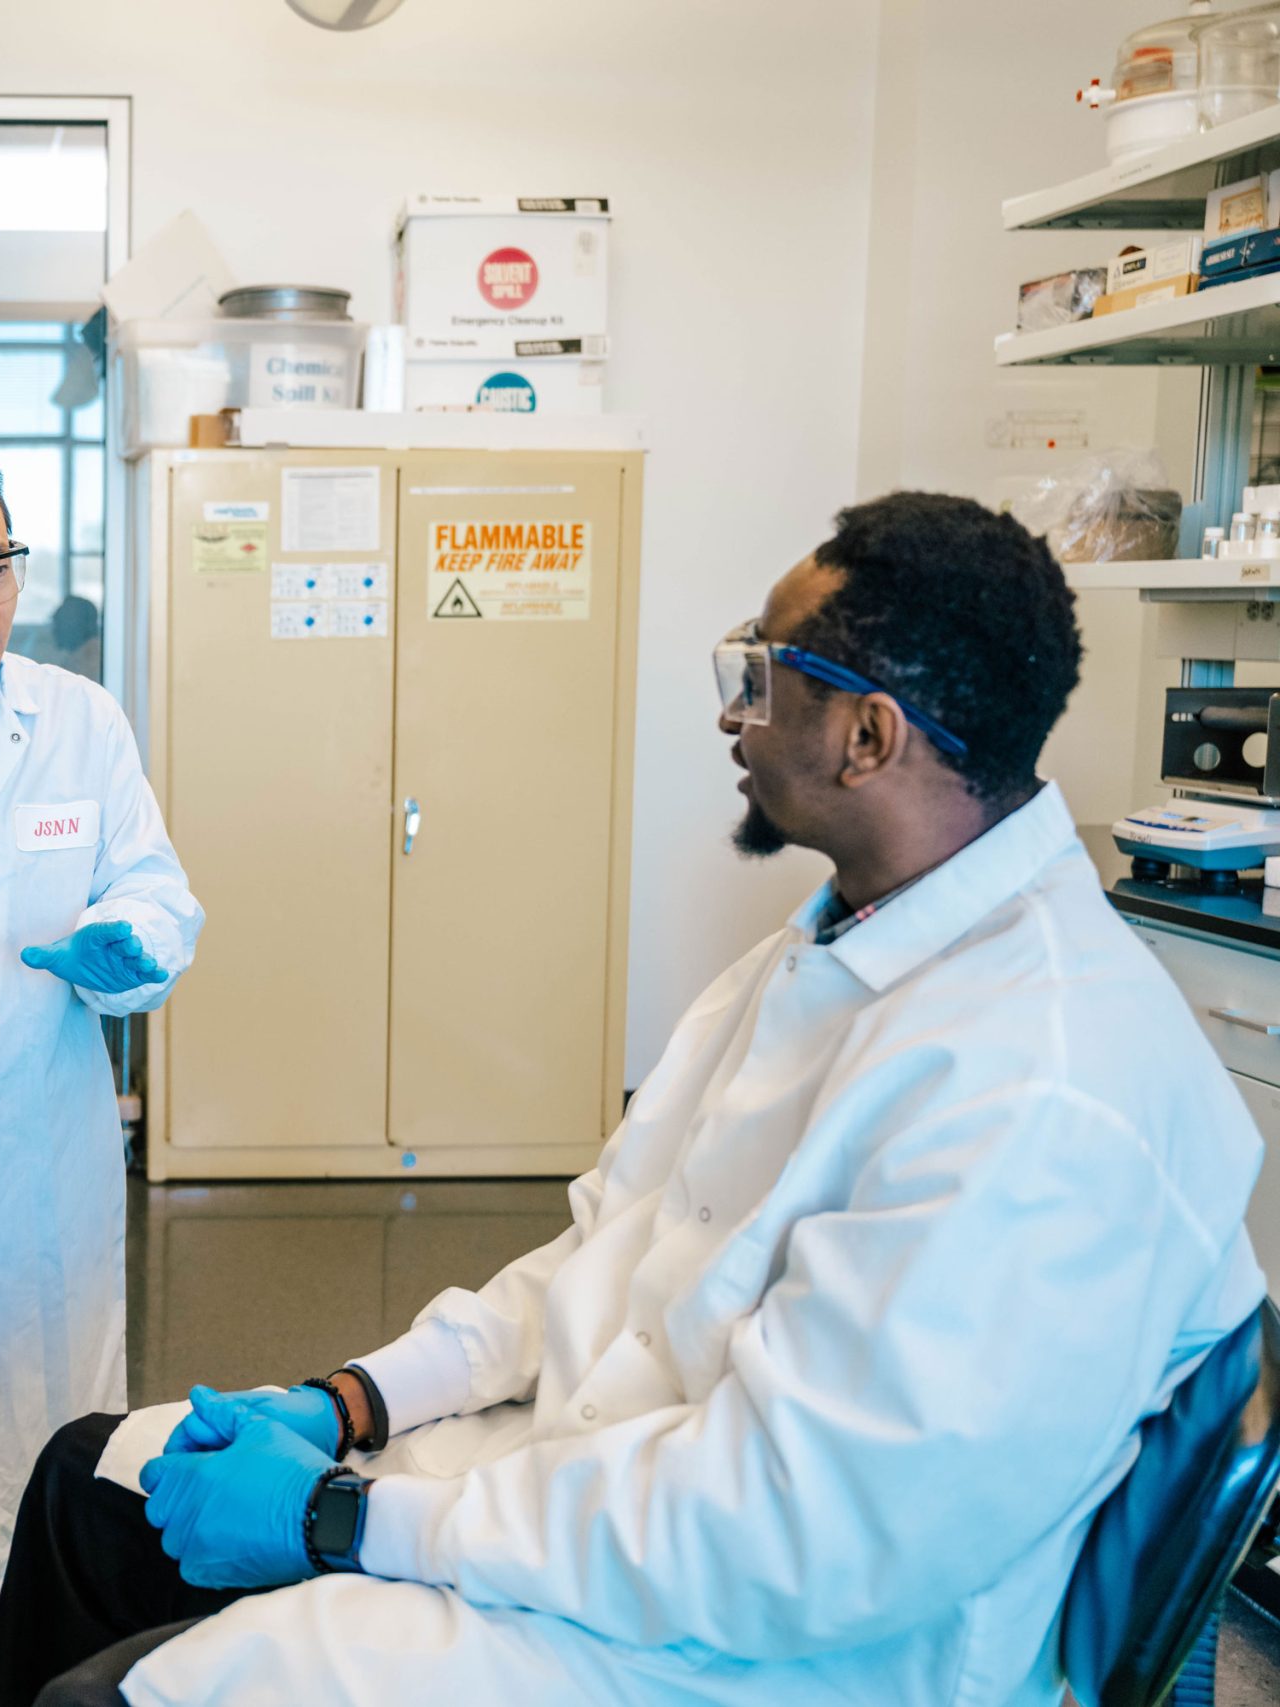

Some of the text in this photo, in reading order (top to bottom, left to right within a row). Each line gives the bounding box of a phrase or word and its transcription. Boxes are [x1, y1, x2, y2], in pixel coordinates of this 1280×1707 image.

[483, 262, 532, 284] SOLVENT
[491, 284, 524, 299] SPILL
[451, 315, 563, 327] Emergency Cleanup Kit
[435, 524, 584, 550] FLAMMABLE
[434, 553, 583, 572] KEEP FIRE AWAY
[34, 817, 80, 836] JSNN
